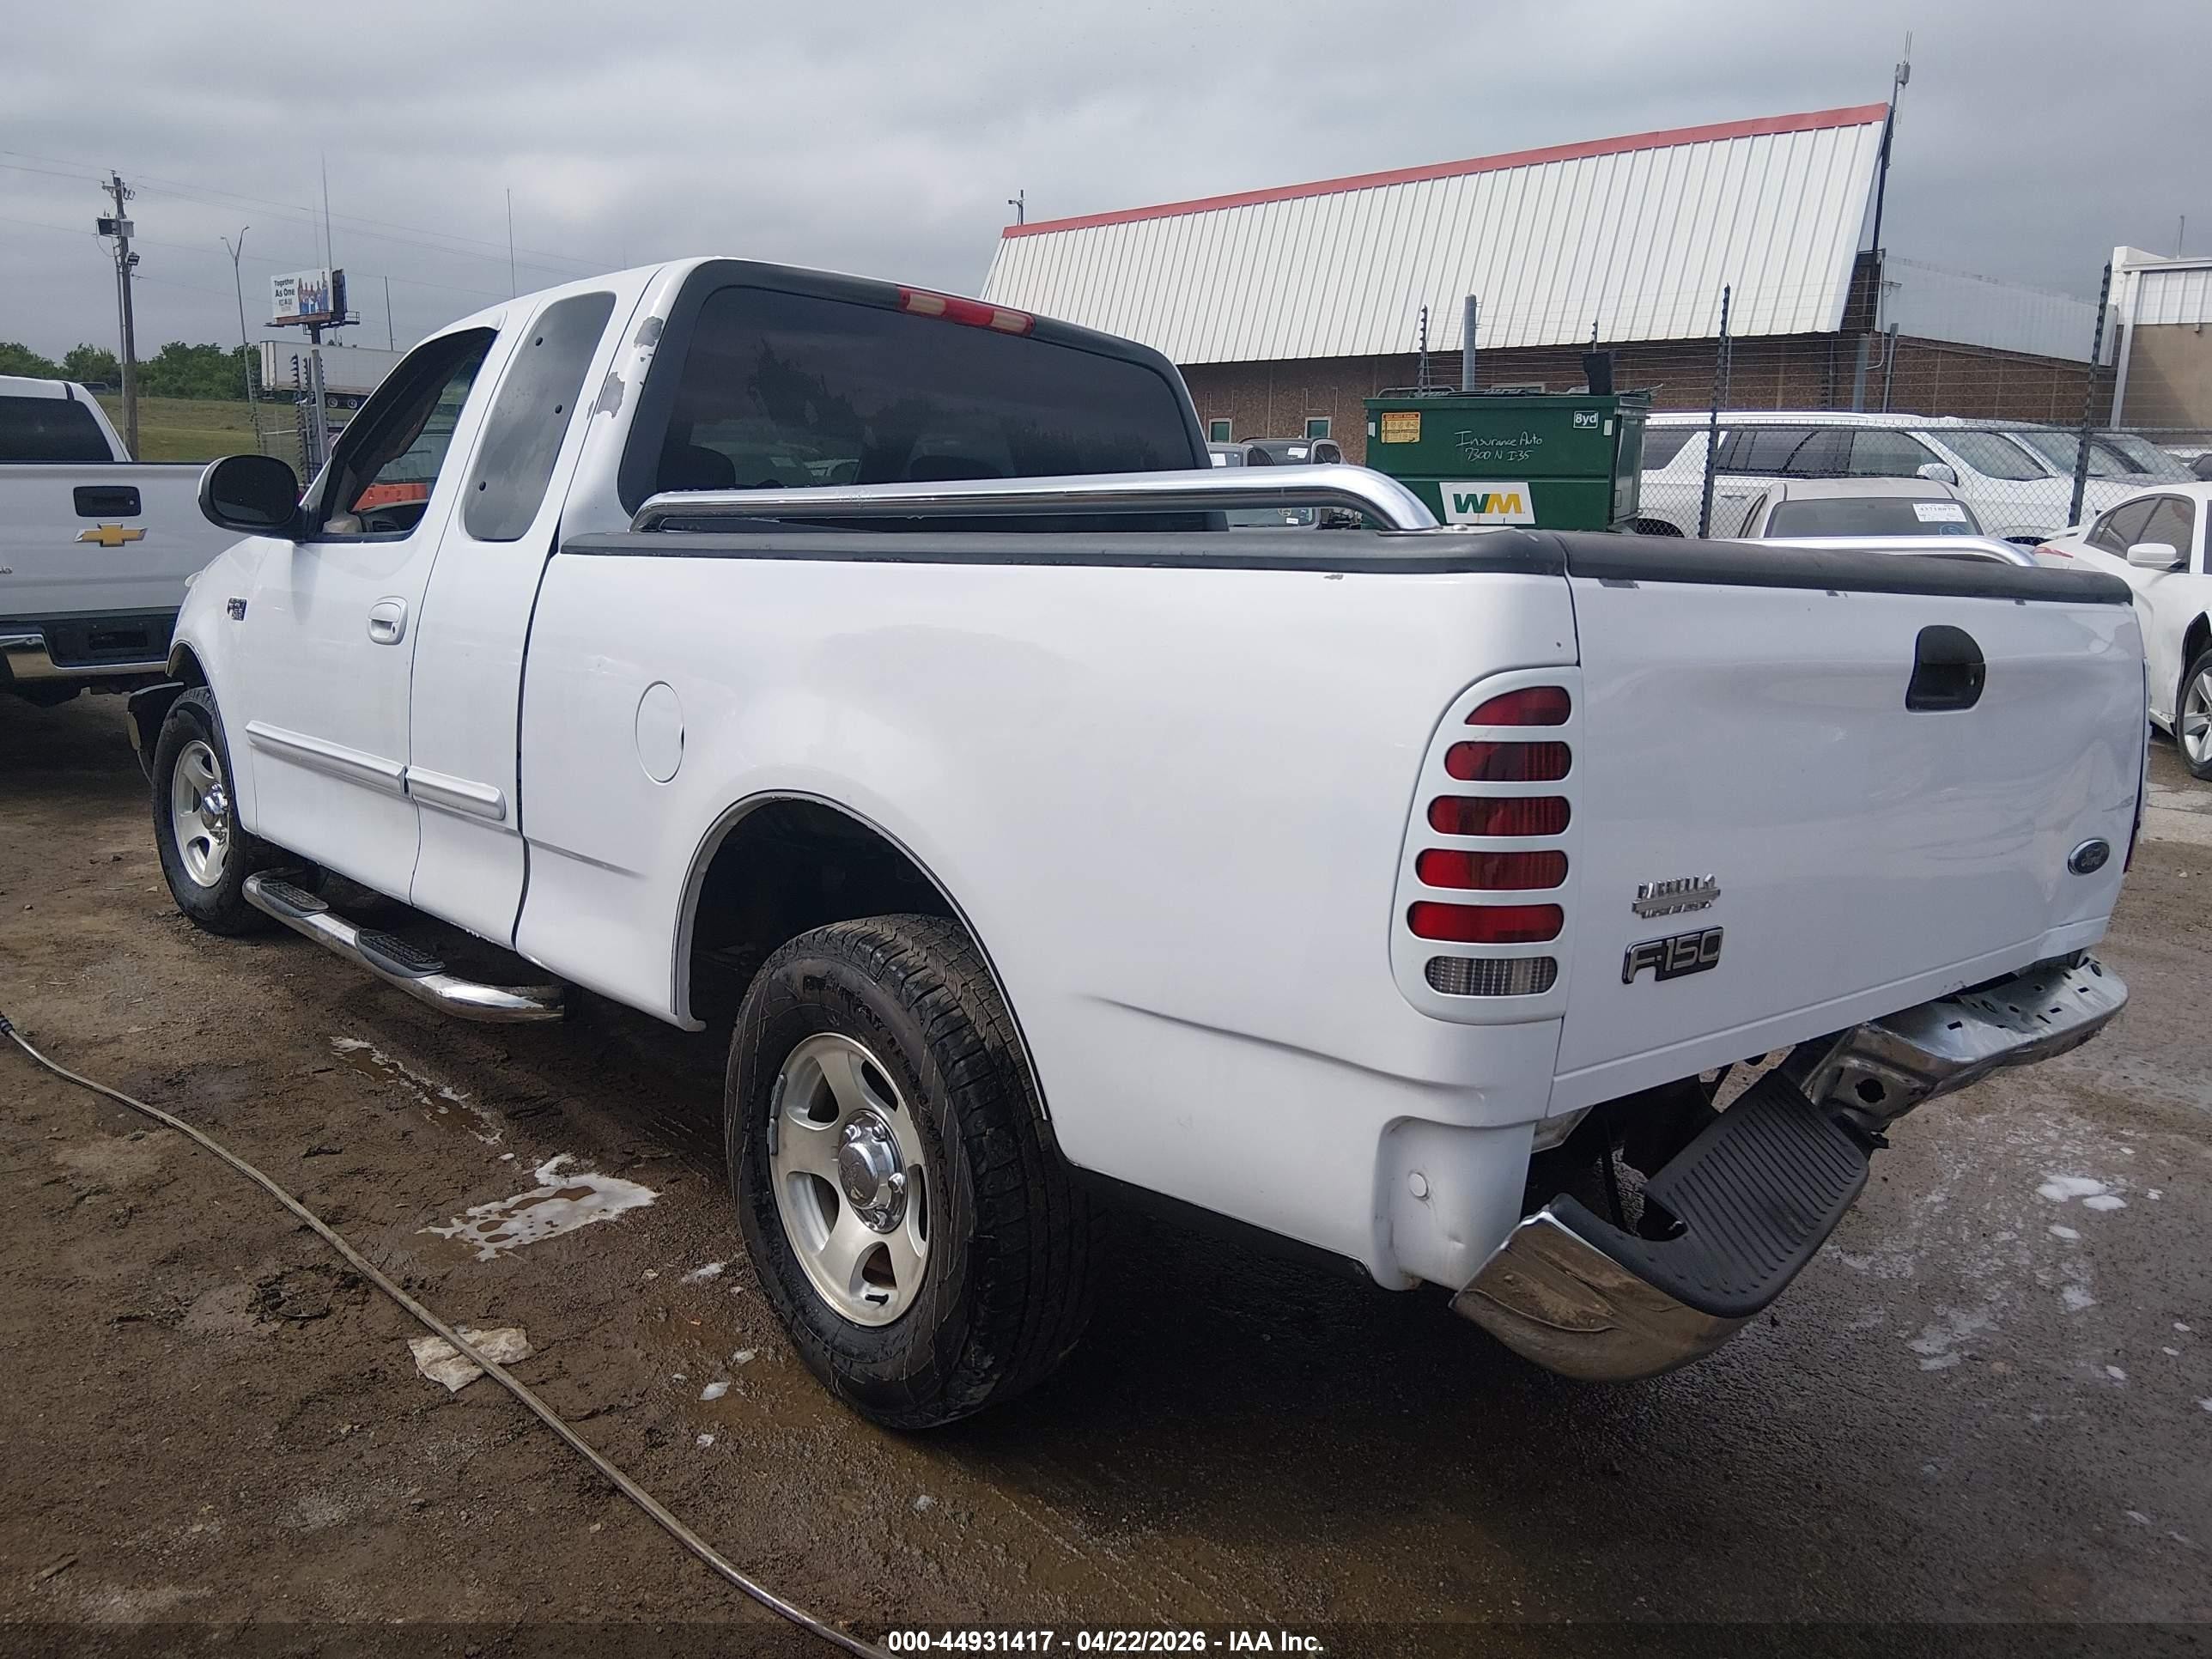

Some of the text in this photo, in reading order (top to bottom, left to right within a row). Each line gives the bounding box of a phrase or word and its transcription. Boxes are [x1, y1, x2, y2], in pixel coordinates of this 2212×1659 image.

[274, 278, 295, 288] Together
[275, 288, 295, 298] As One
[1575, 413, 1597, 426] 8yd
[1454, 430, 1543, 447] Insurance Auto
[1465, 448, 1534, 462] 7300 N I-35
[1453, 493, 1522, 514] WM
